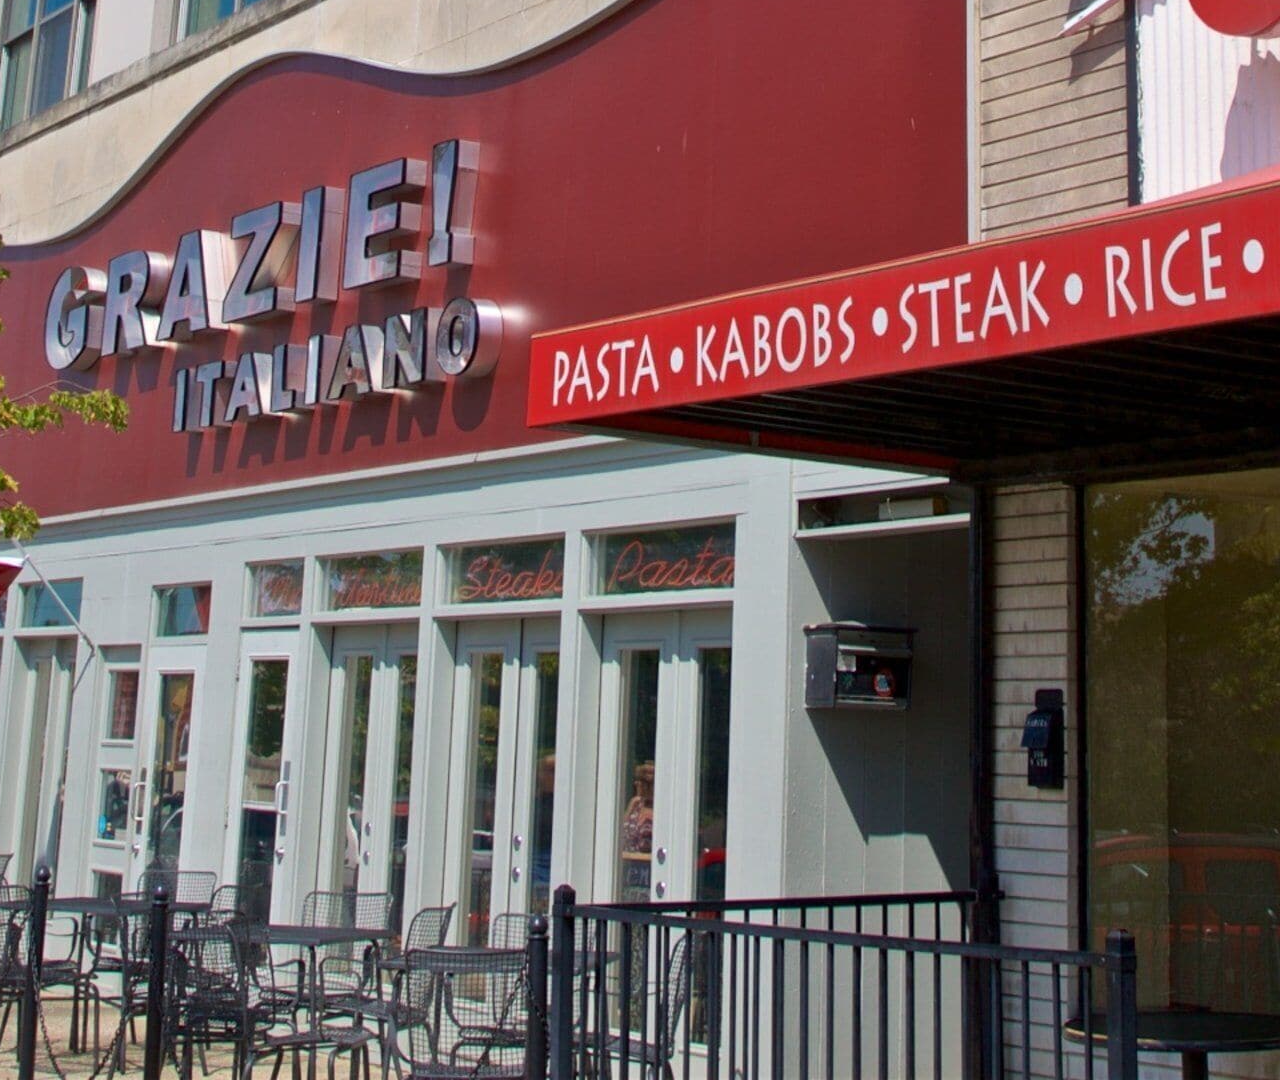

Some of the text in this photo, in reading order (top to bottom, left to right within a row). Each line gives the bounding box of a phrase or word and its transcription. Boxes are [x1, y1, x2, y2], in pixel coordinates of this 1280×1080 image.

[44, 139, 480, 371] GRAZIE!
[551, 338, 660, 407] PASTA
[694, 296, 855, 387] KABOBS
[898, 260, 1051, 354] STEAK
[1104, 222, 1227, 319] RICE
[172, 296, 503, 433] ITALIANO
[606, 535, 736, 593] Pasta
